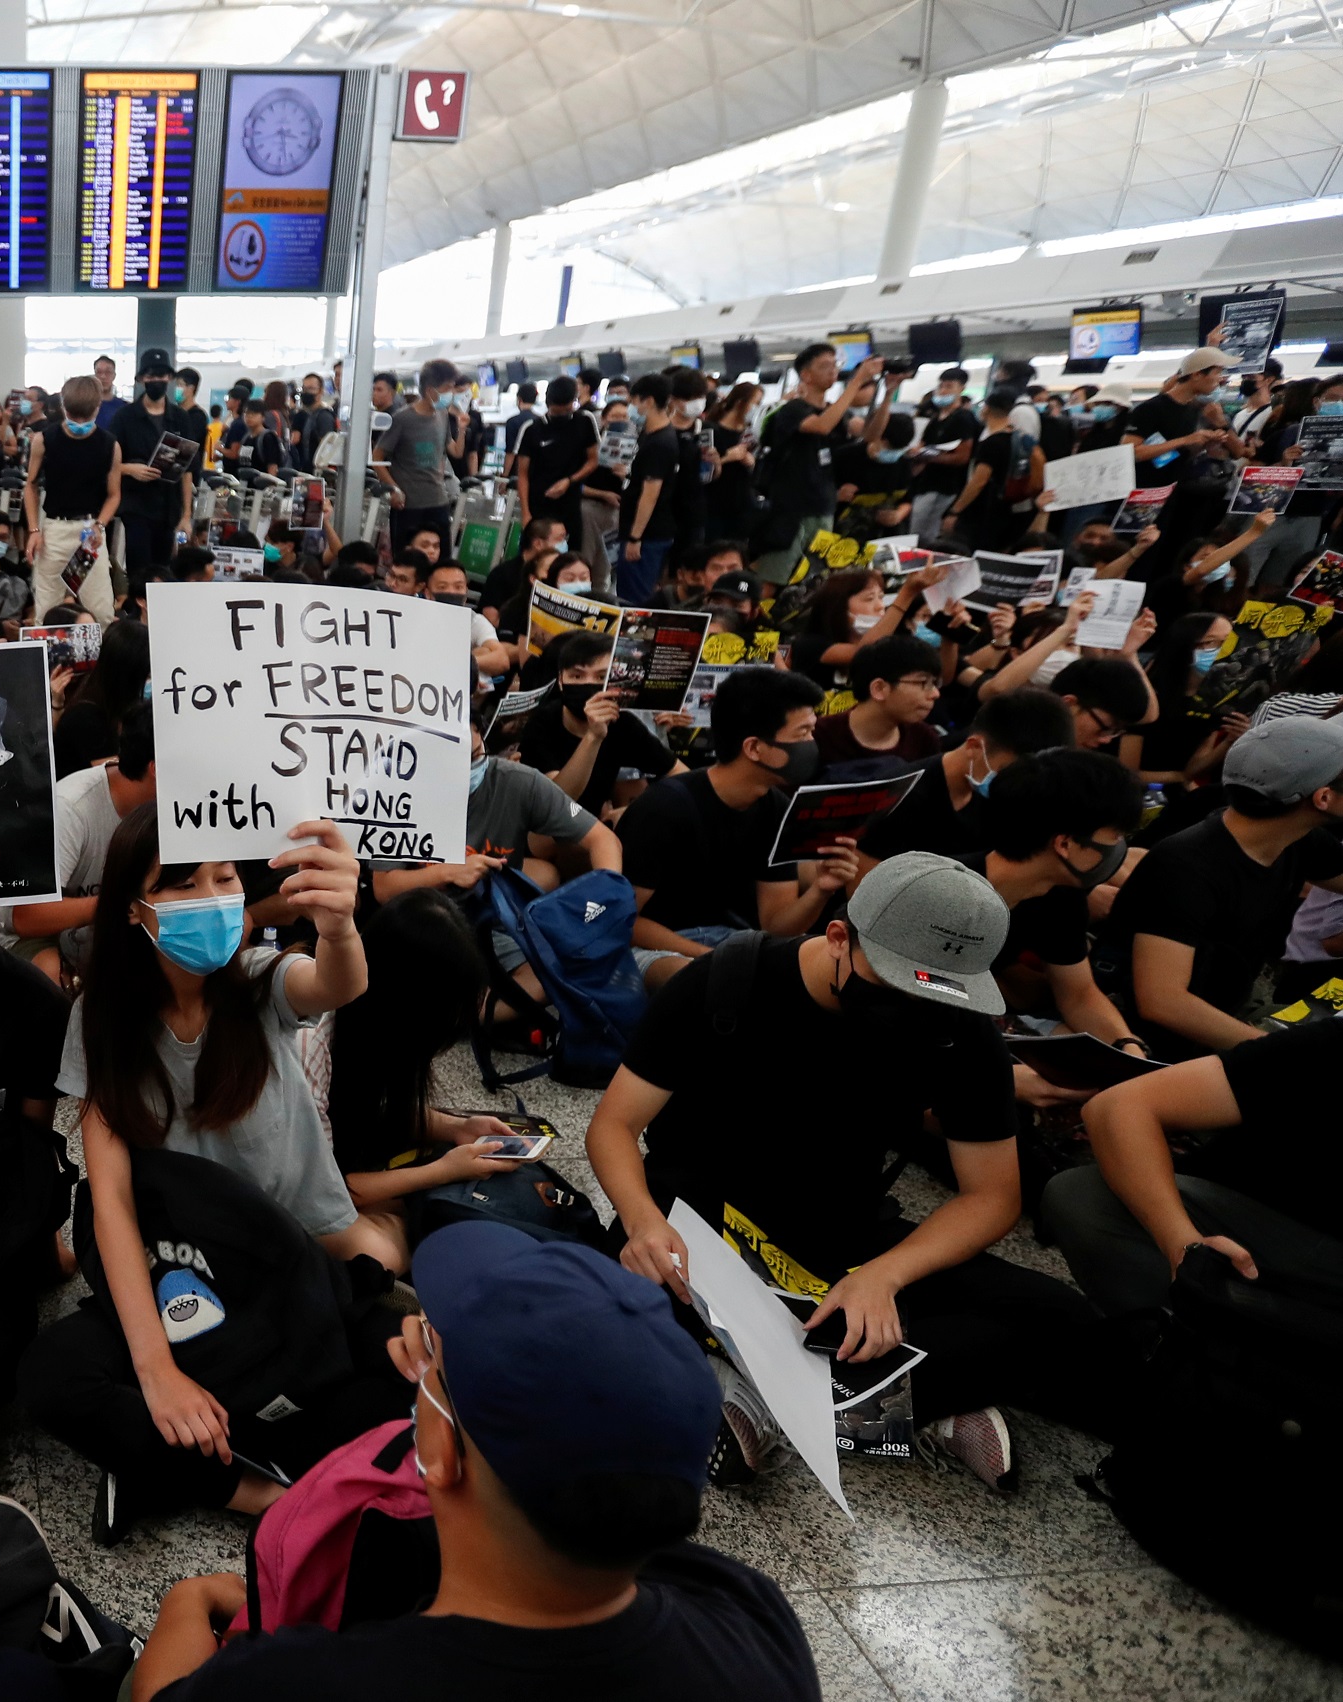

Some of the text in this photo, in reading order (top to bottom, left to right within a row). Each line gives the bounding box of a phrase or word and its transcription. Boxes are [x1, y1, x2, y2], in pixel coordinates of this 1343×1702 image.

[551, 592, 589, 612] HAPPENED
[225, 599, 403, 651] FIGHT
[162, 666, 242, 714] for
[262, 660, 464, 723] FREEDOM
[271, 721, 418, 781] STAND
[173, 777, 412, 830] with HONG
[357, 824, 435, 858] KONG
[930, 923, 957, 936] UNDER
[882, 1442, 910, 1453] 008
